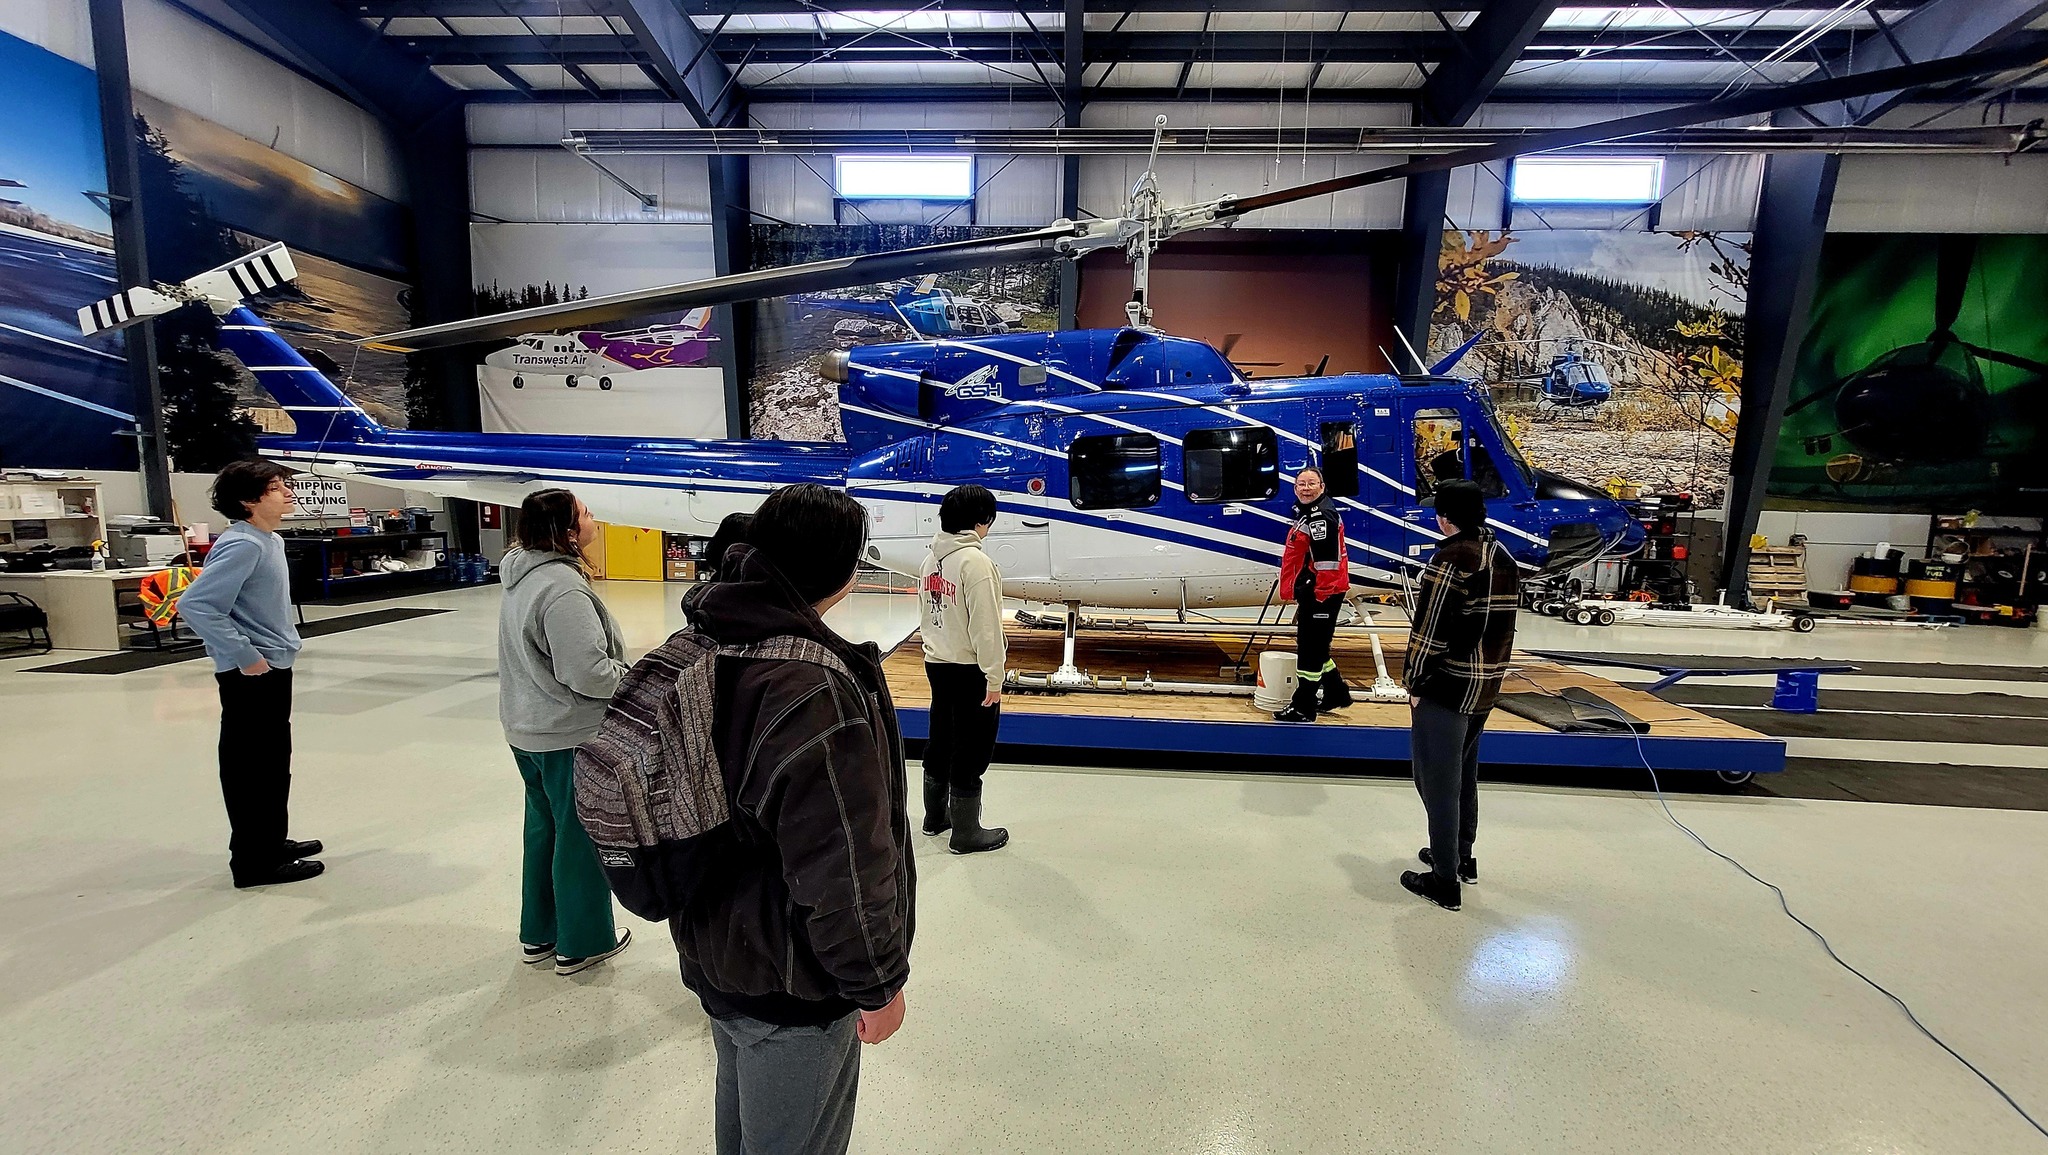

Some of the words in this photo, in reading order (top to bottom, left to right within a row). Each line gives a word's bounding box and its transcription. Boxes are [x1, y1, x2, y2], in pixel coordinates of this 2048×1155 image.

[512, 354, 568, 365] Transwest
[570, 354, 588, 365] Air
[956, 383, 1002, 400] GSH
[291, 496, 347, 505] ECEIVING
